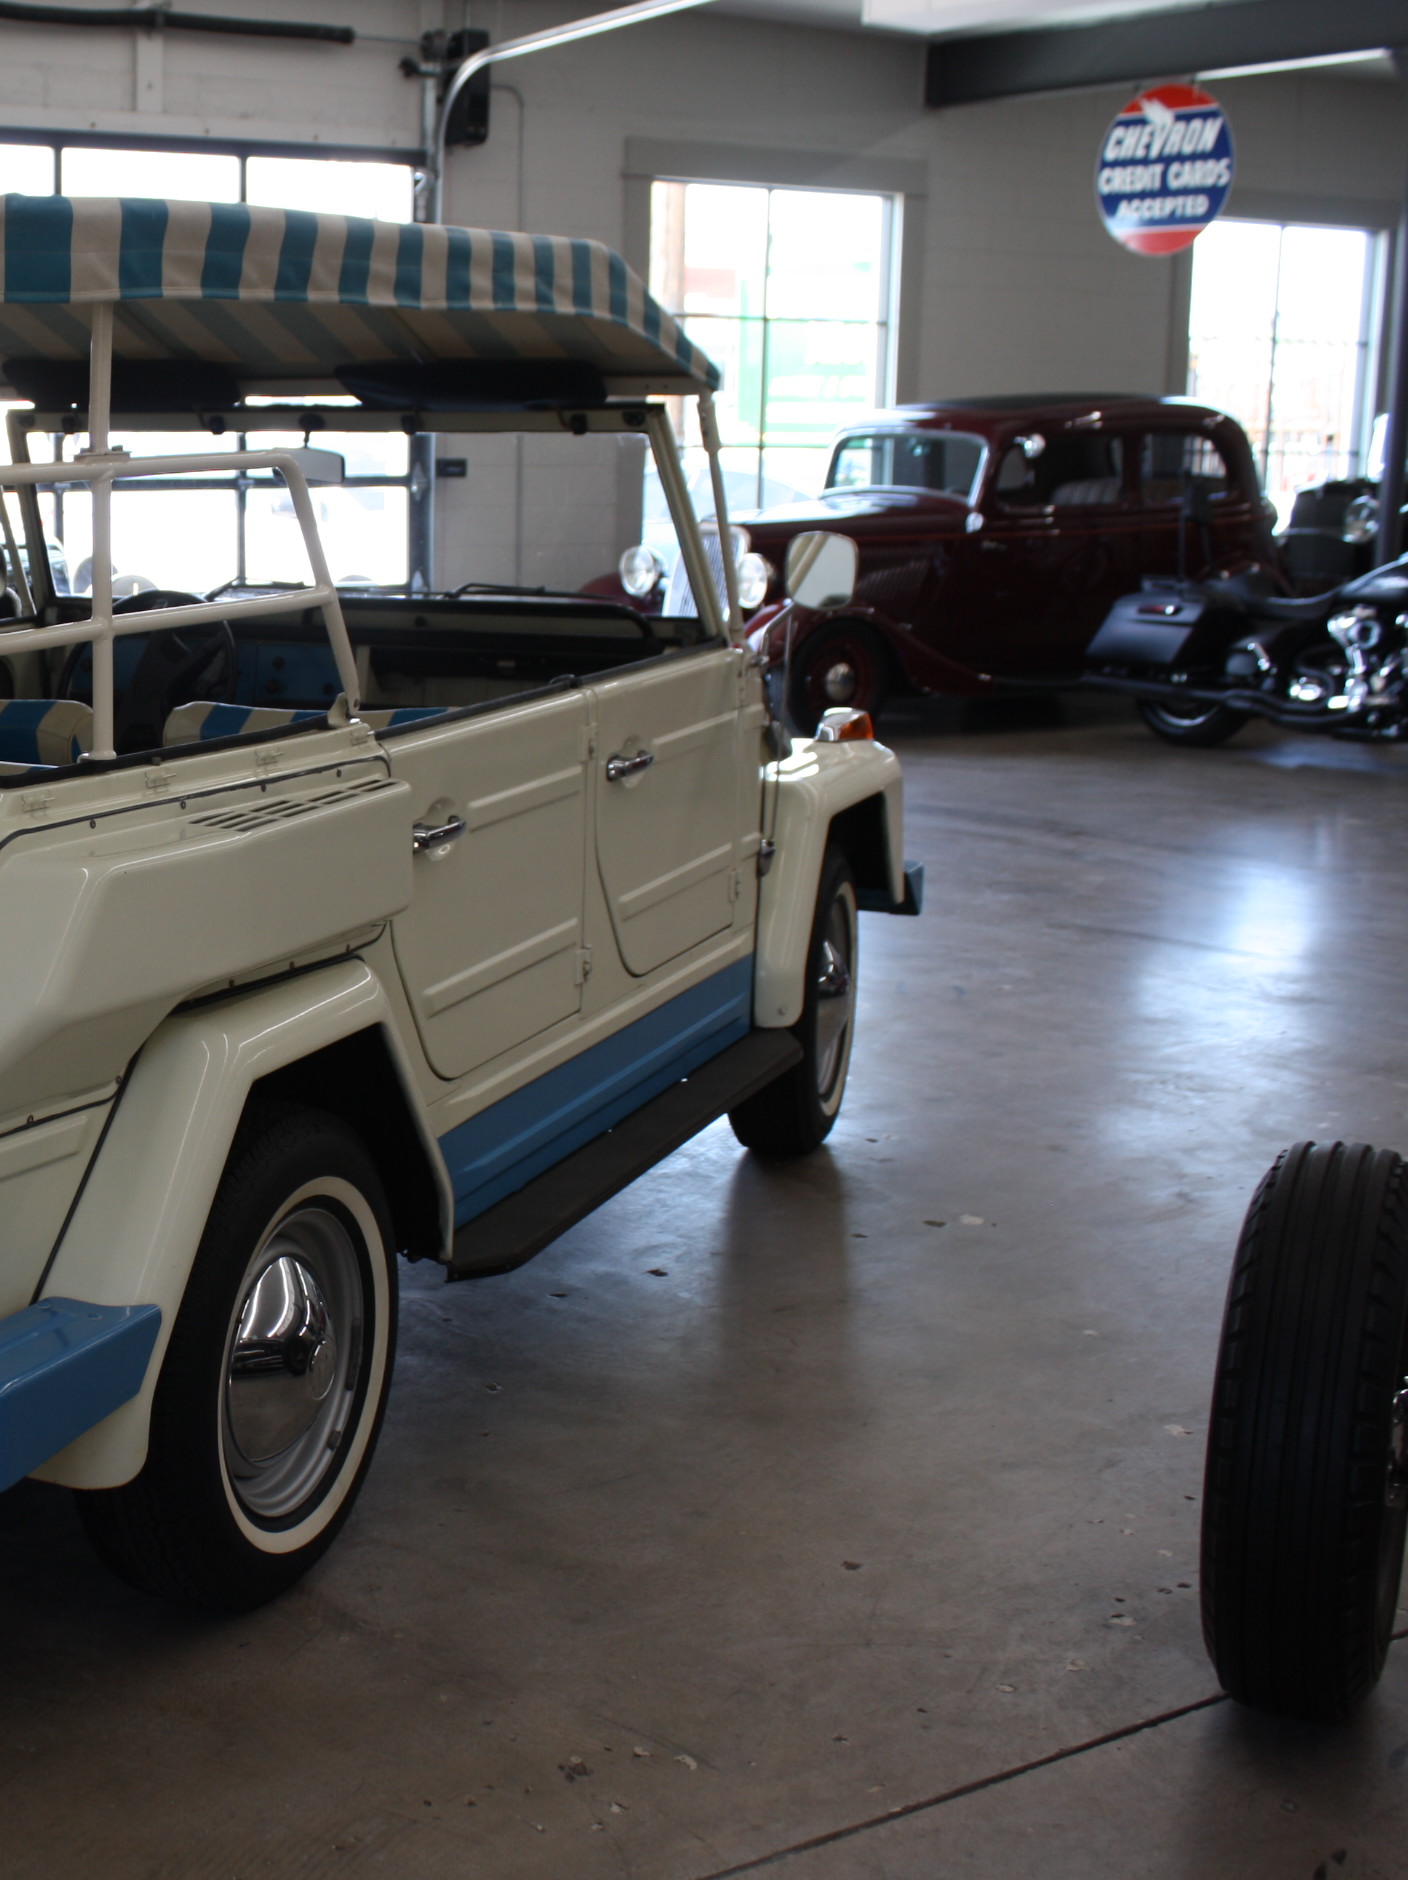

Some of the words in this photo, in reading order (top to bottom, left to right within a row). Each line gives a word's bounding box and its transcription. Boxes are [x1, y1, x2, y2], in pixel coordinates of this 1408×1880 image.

[1104, 117, 1223, 161] CHEVRON
[1098, 163, 1164, 195] CREDIT
[1167, 158, 1231, 190] CARDS
[1114, 195, 1209, 220] ACCEPTED
